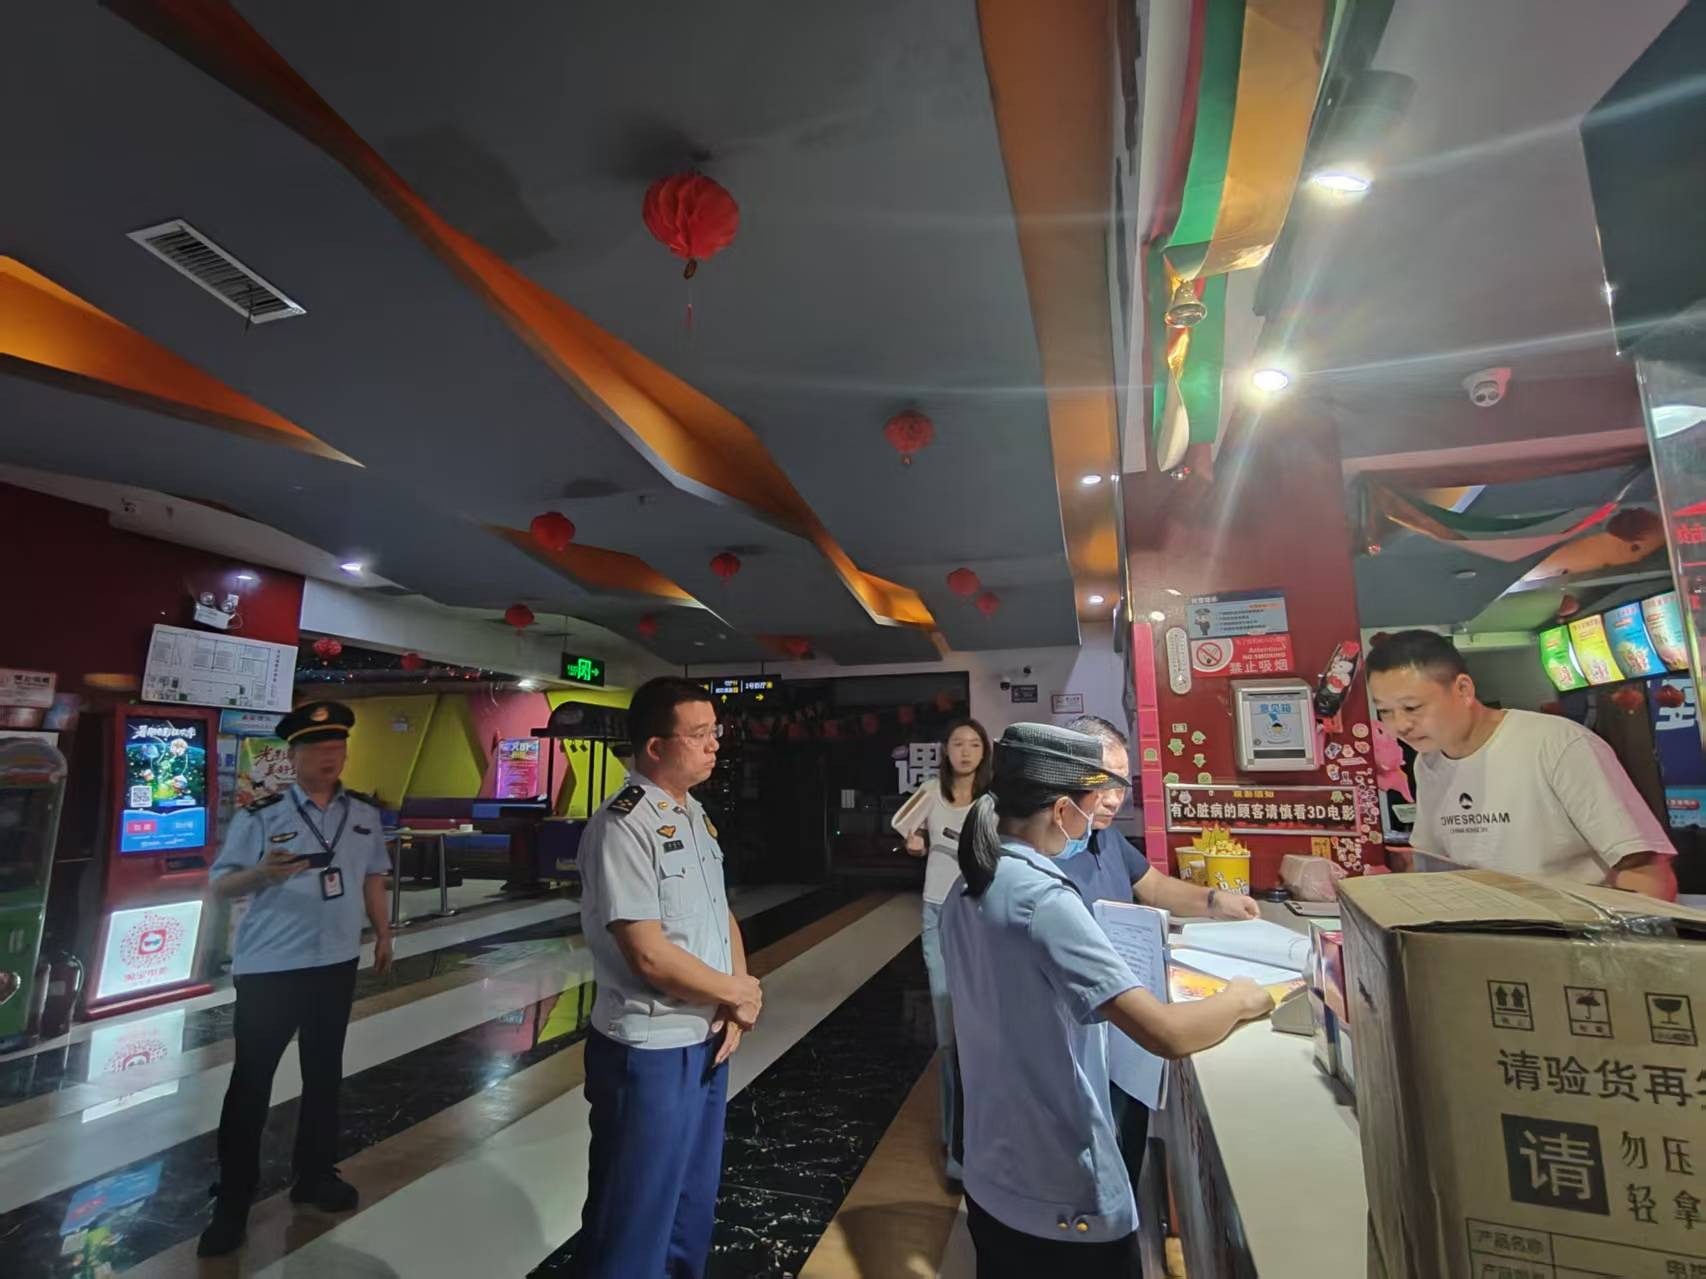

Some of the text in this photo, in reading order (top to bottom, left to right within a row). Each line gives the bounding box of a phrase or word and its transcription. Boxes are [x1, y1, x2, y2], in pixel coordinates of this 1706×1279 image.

[1230, 658, 1288, 674] 禁止吸烟
[1260, 703, 1292, 713] 意见箱
[1170, 802, 1356, 822] 有心脏病的顾客请慎看3D电影
[1496, 1048, 1706, 1108] 请验货再
[1519, 1128, 1596, 1201] 请
[1621, 1130, 1695, 1176] 勿压
[1626, 1183, 1702, 1230] 轻拿
